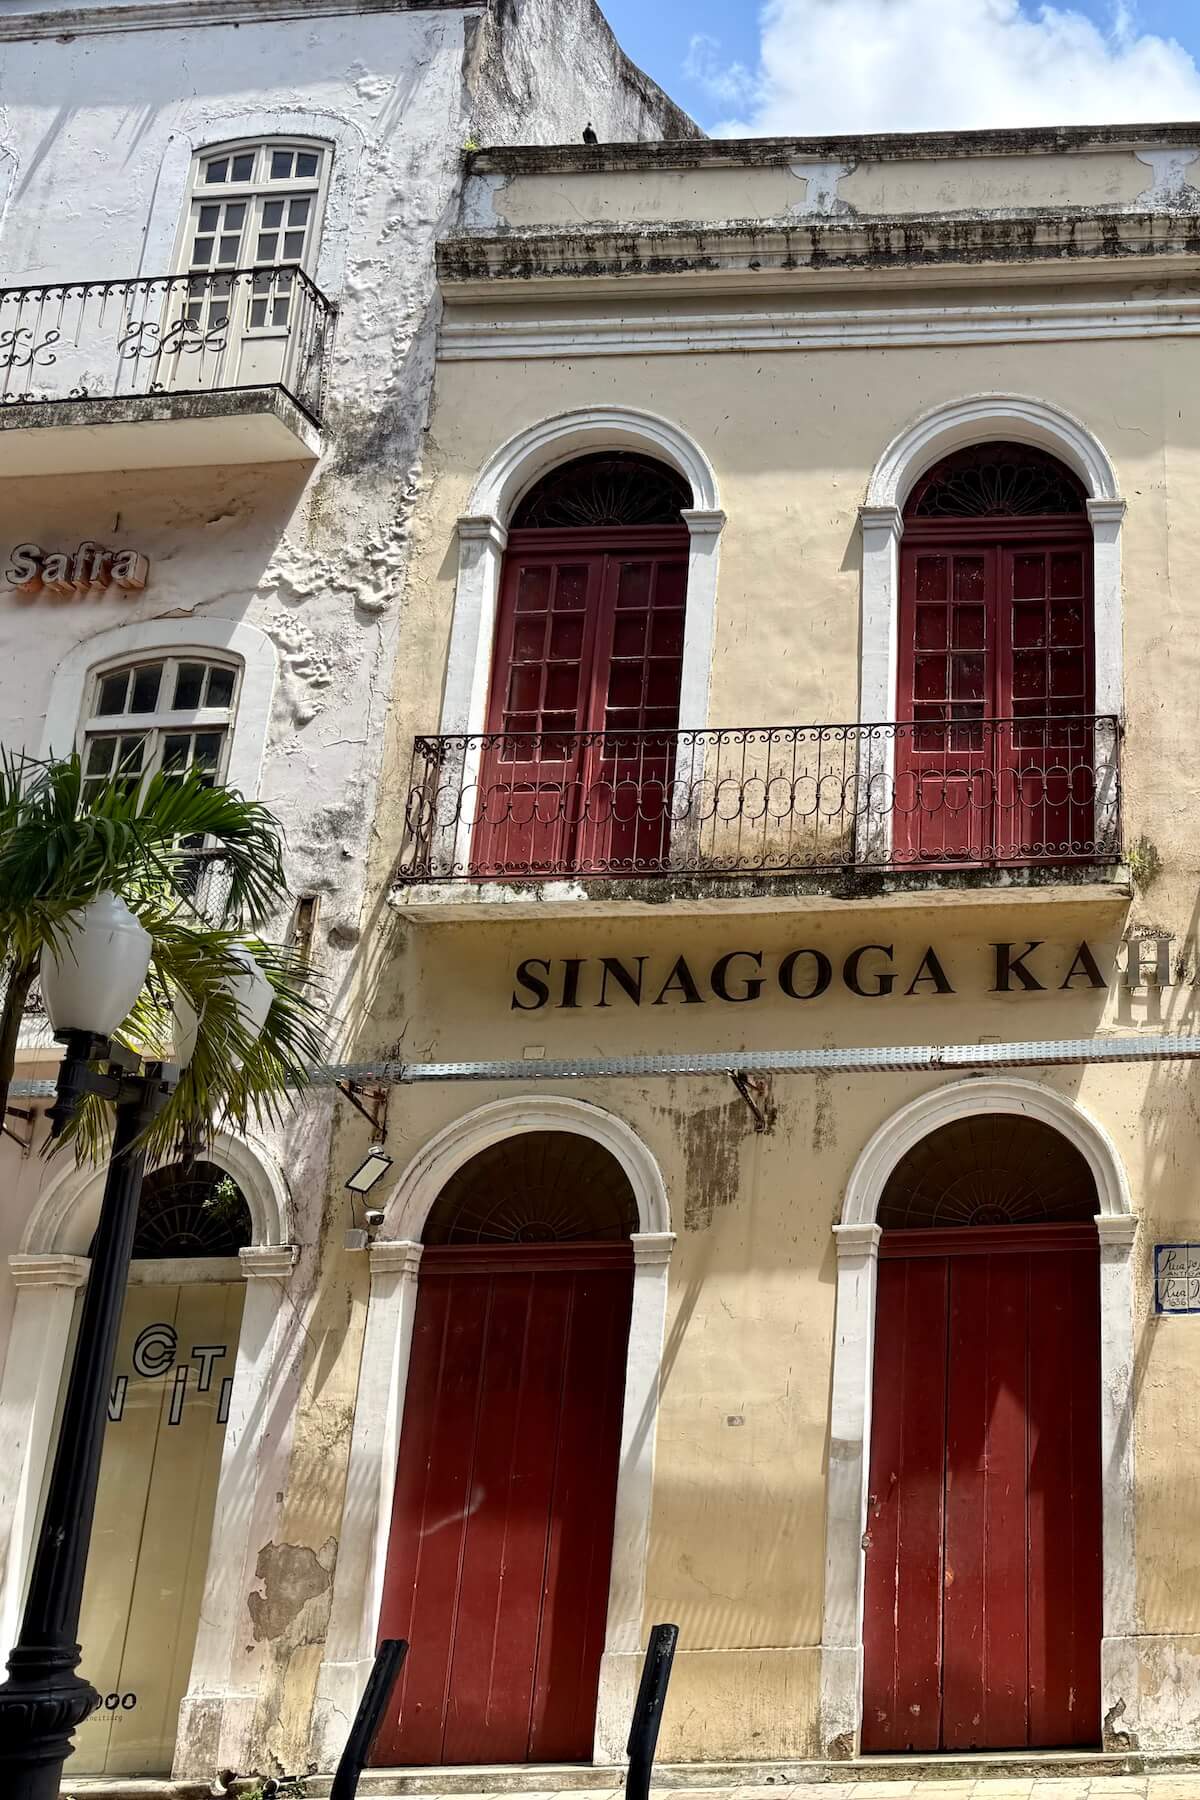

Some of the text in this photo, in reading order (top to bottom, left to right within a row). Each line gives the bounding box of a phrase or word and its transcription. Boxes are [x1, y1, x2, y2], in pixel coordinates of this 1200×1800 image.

[5, 541, 148, 591] Safra
[511, 943, 957, 1012] SINAGOGA
[1161, 1250, 1186, 1272] Rua
[1160, 1279, 1187, 1300] Rua
